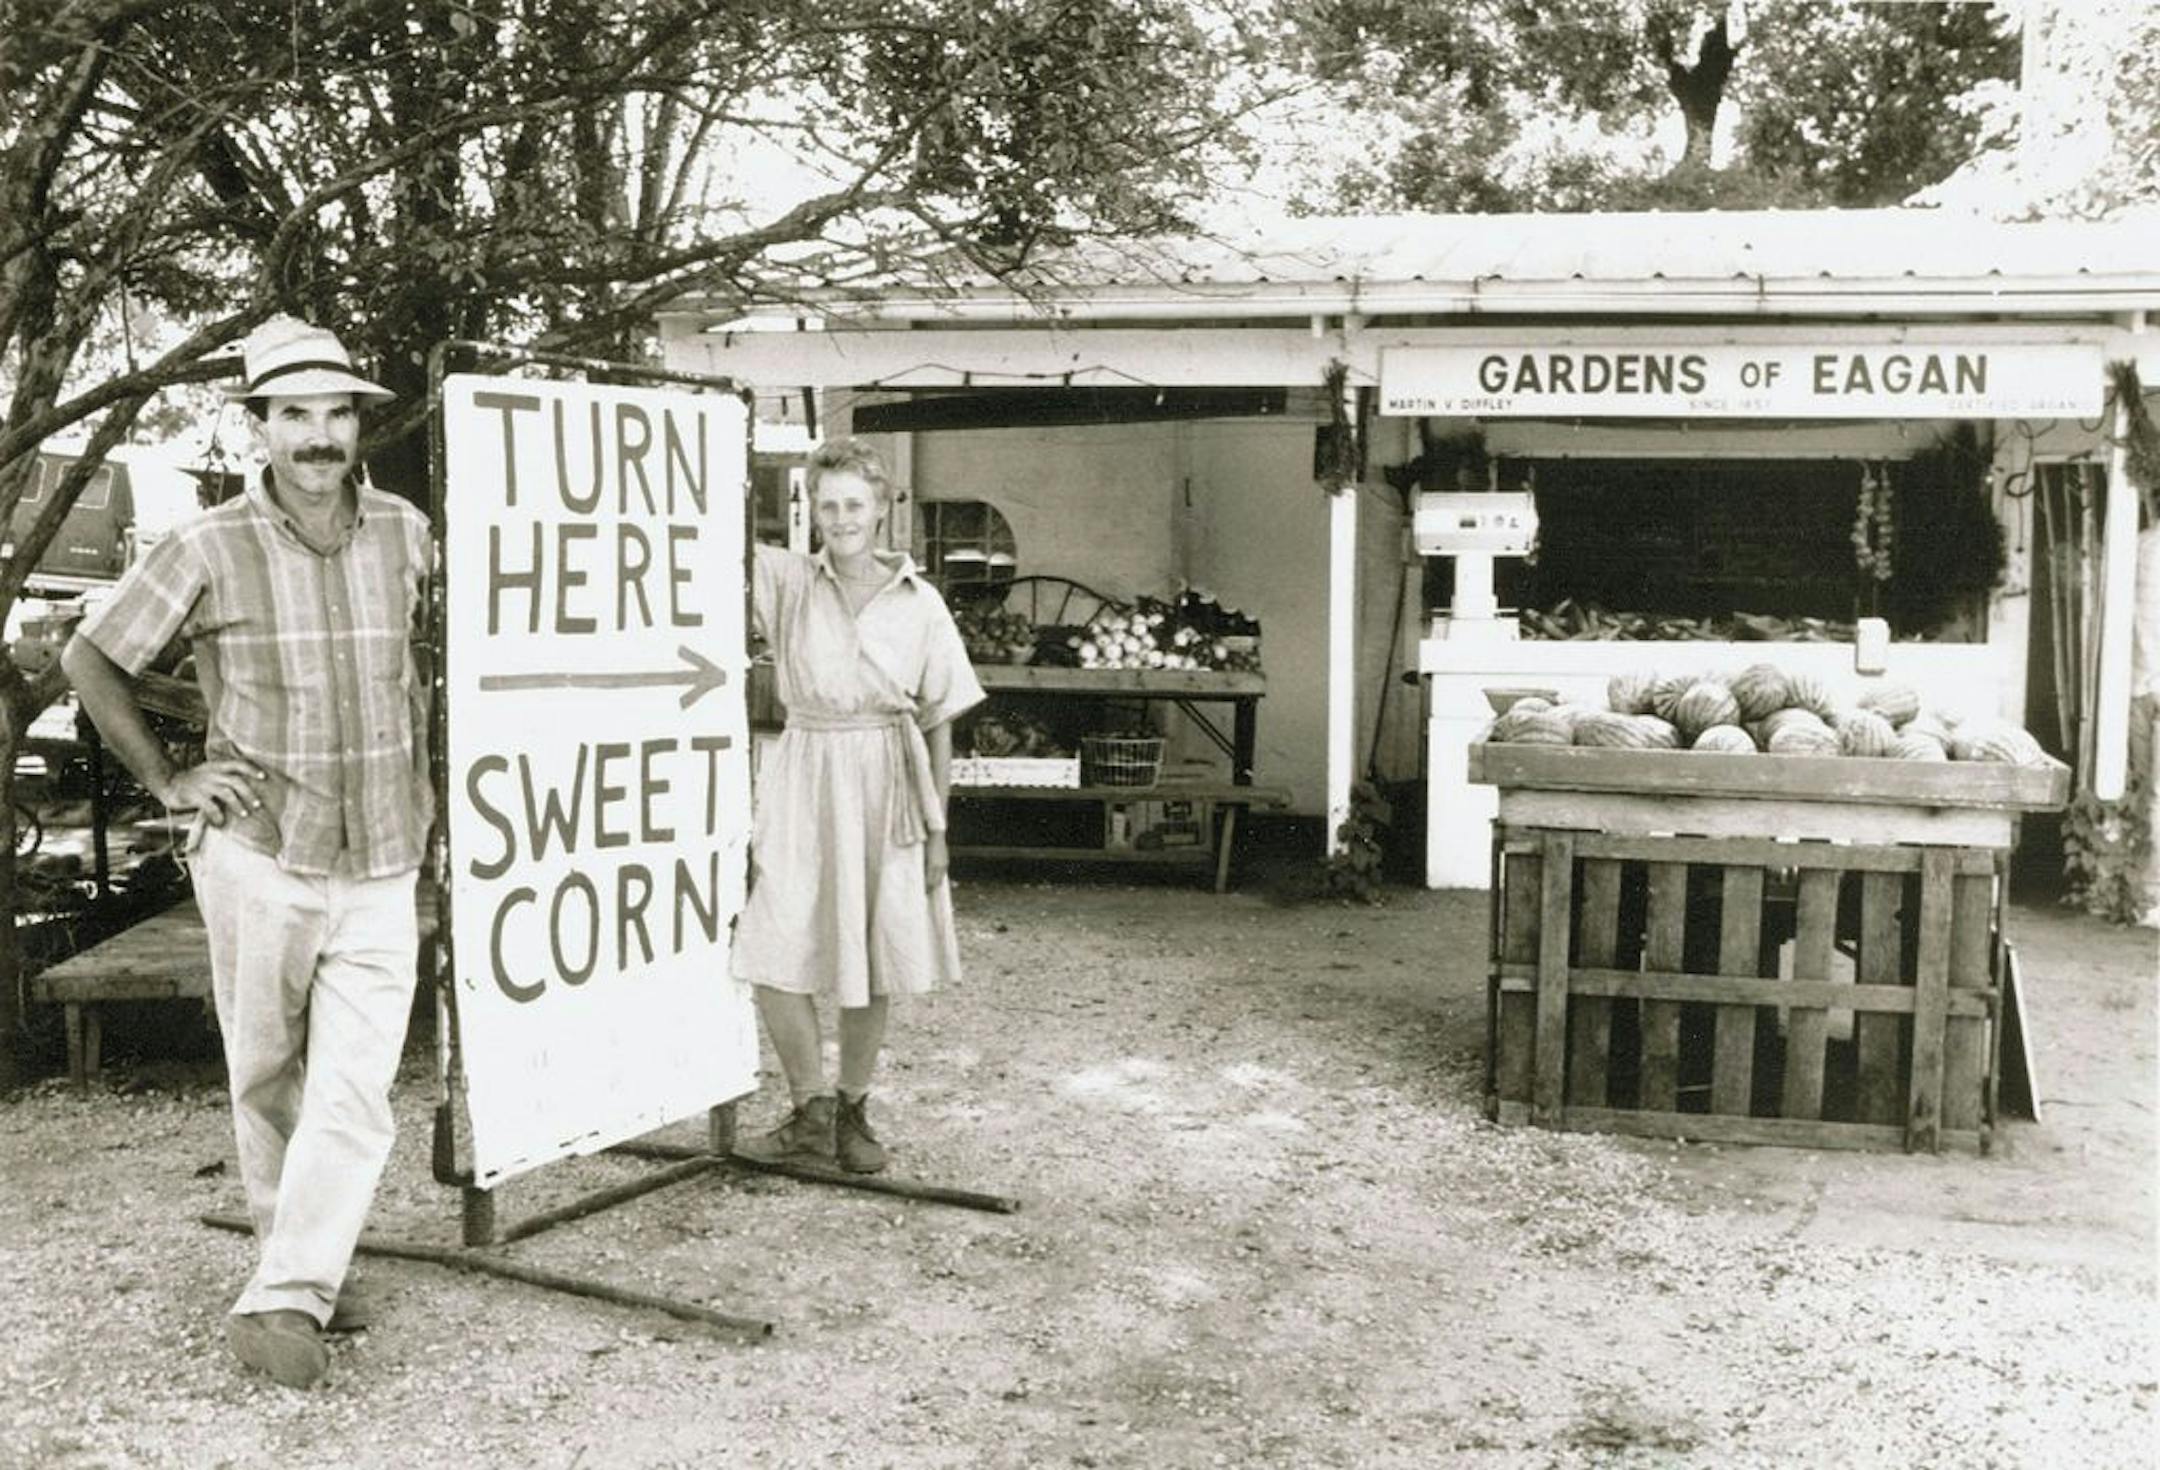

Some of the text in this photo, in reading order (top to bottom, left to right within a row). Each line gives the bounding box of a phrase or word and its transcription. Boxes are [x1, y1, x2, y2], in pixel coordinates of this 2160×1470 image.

[1478, 353, 1988, 395] GARDENS OF EAGAN
[472, 390, 708, 516] TURN
[487, 520, 704, 636] HERE
[465, 735, 733, 882] SWEET
[488, 850, 720, 1005] CORN
